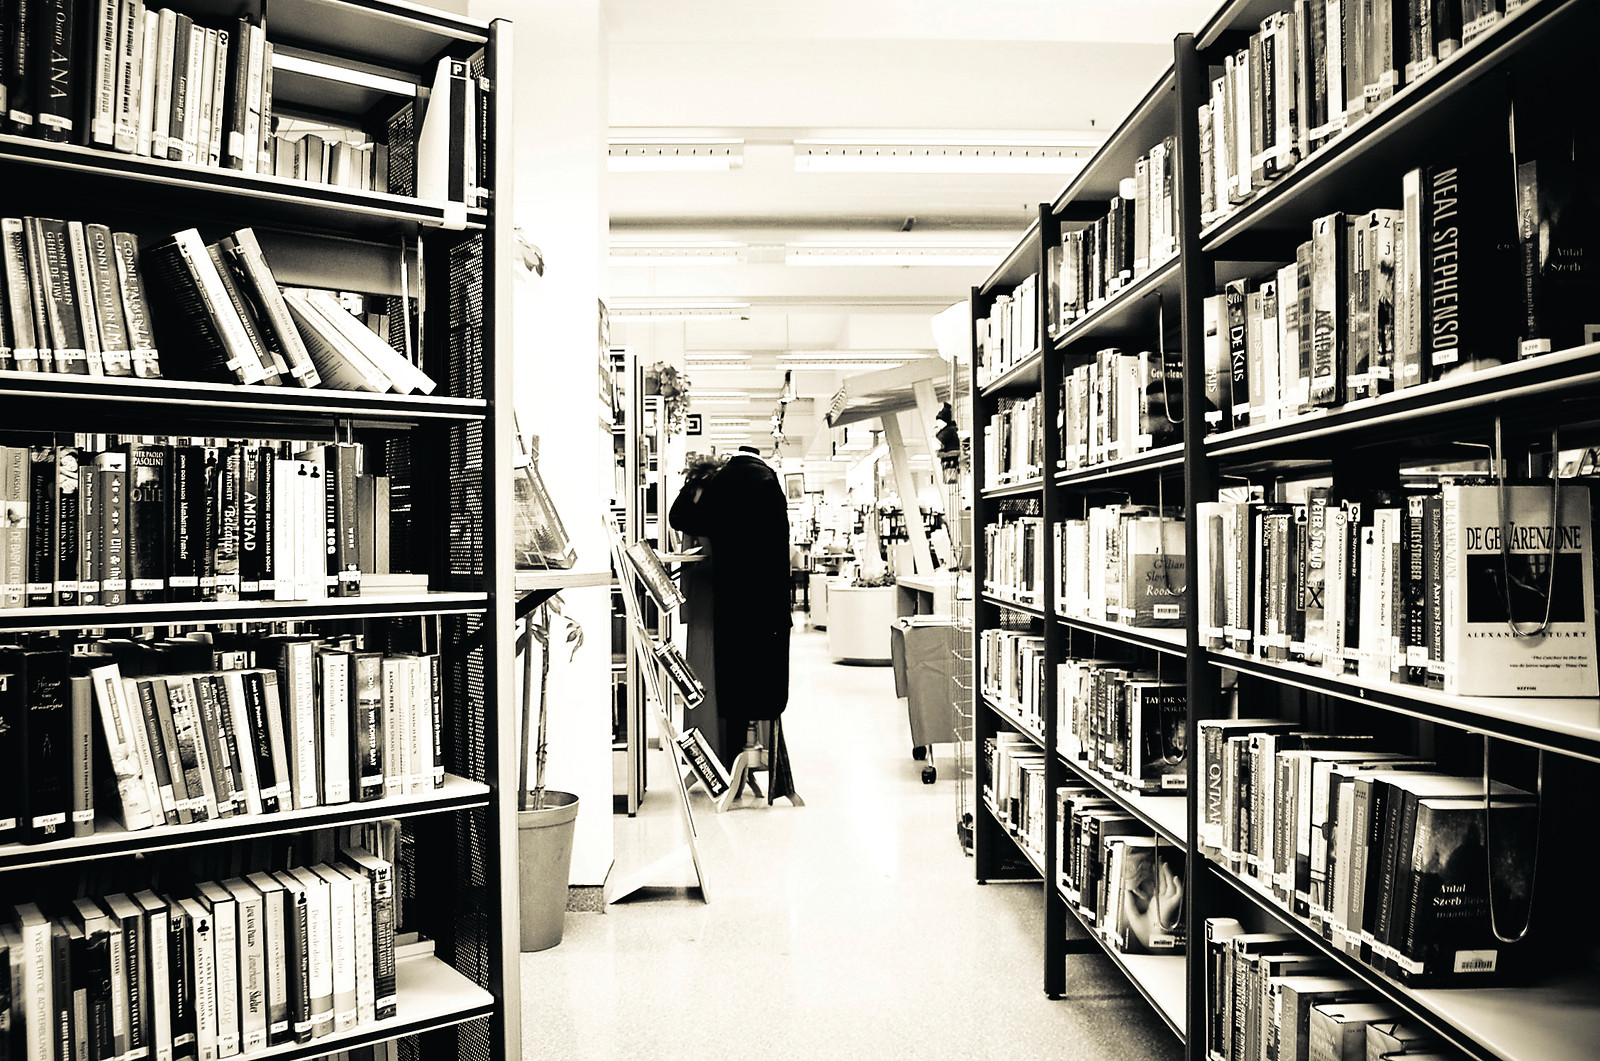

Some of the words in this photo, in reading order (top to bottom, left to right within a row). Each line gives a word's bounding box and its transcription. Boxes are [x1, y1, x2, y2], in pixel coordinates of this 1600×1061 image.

[106, 7, 114, 20] van
[55, 12, 67, 46] Osorio
[50, 49, 69, 98] ANA
[102, 54, 111, 92] verzameld
[124, 62, 132, 96] verzameld
[101, 92, 109, 114] proza
[1433, 167, 1458, 227] NEAL
[47, 231, 58, 264] GEHEEL
[58, 232, 69, 268] CONNIE
[95, 233, 109, 275] CONNIE
[123, 240, 138, 282] CONNIE
[51, 267, 60, 279] DE
[53, 282, 63, 303] UWE
[62, 270, 73, 306] PALMEN
[101, 279, 116, 321] PALMEN
[1431, 226, 1459, 350] STEPHENSO
[129, 286, 145, 327] PALMEN
[13, 451, 22, 469] TONY
[133, 457, 164, 466] PASOLINI
[12, 470, 22, 500] PARSONS
[132, 488, 163, 502] OLIE
[68, 498, 76, 518] TONY
[244, 491, 257, 551] AMISTAD
[1311, 497, 1327, 528] PETER
[68, 520, 76, 554] PARSONS
[224, 505, 237, 554] Belcanto
[1410, 517, 1423, 544] HITLEY
[1432, 508, 1441, 550] Elizabeth
[1466, 527, 1482, 550] DE
[1310, 529, 1326, 569] STRAUB
[1411, 543, 1423, 581] STRIEBER
[1153, 558, 1185, 570] Gllian
[1433, 551, 1441, 580] Strout
[1306, 586, 1324, 609] X
[1432, 582, 1442, 606] AMY
[200, 681, 210, 699] Koen
[1144, 696, 1175, 705] TAYOR
[1209, 763, 1222, 826] ONTAAR
[1432, 896, 1462, 907] Szerb
[1440, 883, 1466, 893] Antal
[35, 930, 44, 953] YVES
[128, 929, 136, 953] CARYL
[36, 954, 44, 980] PETRY
[129, 954, 137, 986] PHILLIPS
[37, 982, 45, 994] DE
[220, 947, 235, 1025] MoederZorg
[249, 990, 262, 1014] Shelter
[132, 1028, 140, 1046] KUST
